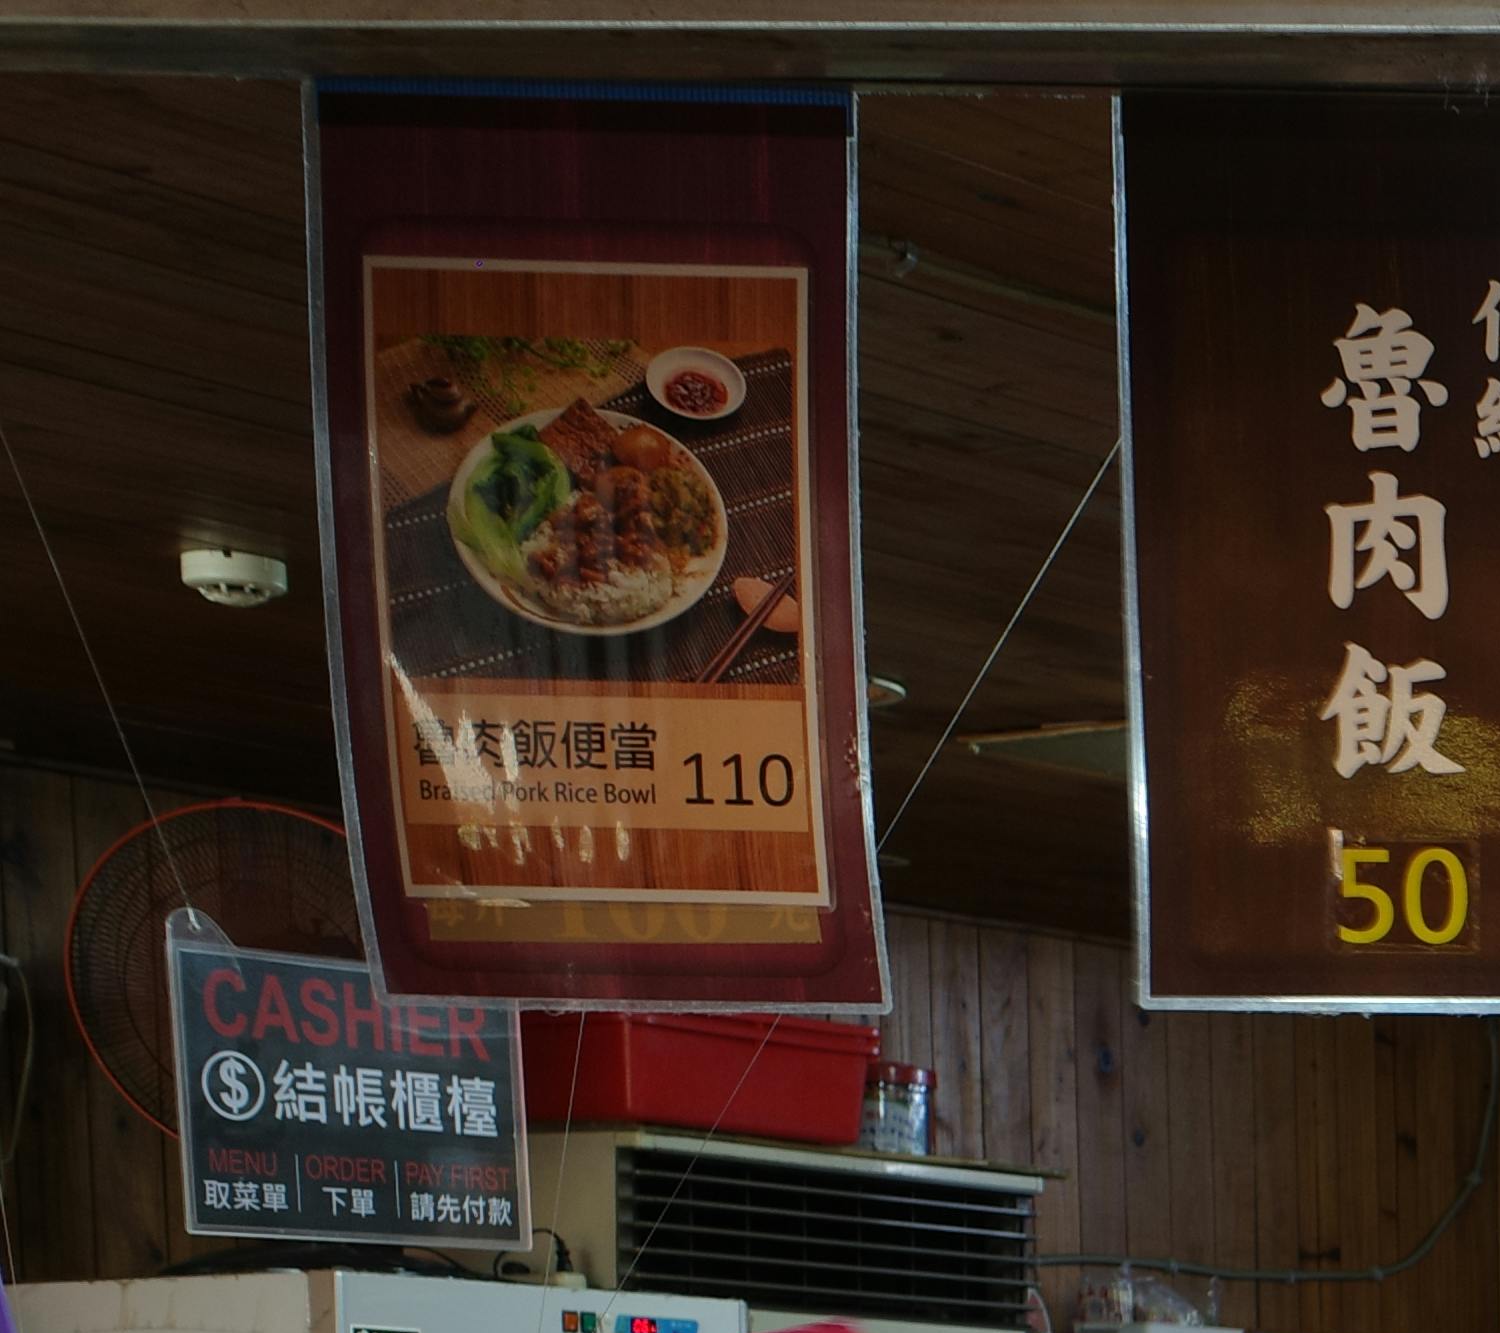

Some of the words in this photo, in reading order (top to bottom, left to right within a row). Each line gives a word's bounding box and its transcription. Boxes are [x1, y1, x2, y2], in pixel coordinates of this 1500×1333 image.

[1321, 303, 1466, 779] 魯肉飯
[504, 780, 548, 803] Pork
[555, 781, 598, 804] Rice
[604, 783, 657, 805] Bowl
[683, 753, 795, 807] 110
[1338, 847, 1469, 947] 50
[203, 968, 489, 1061] CASHIER
[273, 1059, 498, 1138] 結帳櫃檯
[208, 1148, 277, 1176] MENU
[305, 1155, 386, 1184] ORDER
[405, 1163, 443, 1187] PAY
[451, 1166, 511, 1192] FIRST
[203, 1179, 288, 1212] 取菜單
[322, 1186, 376, 1218] 下單
[410, 1192, 512, 1227] 請先付款
